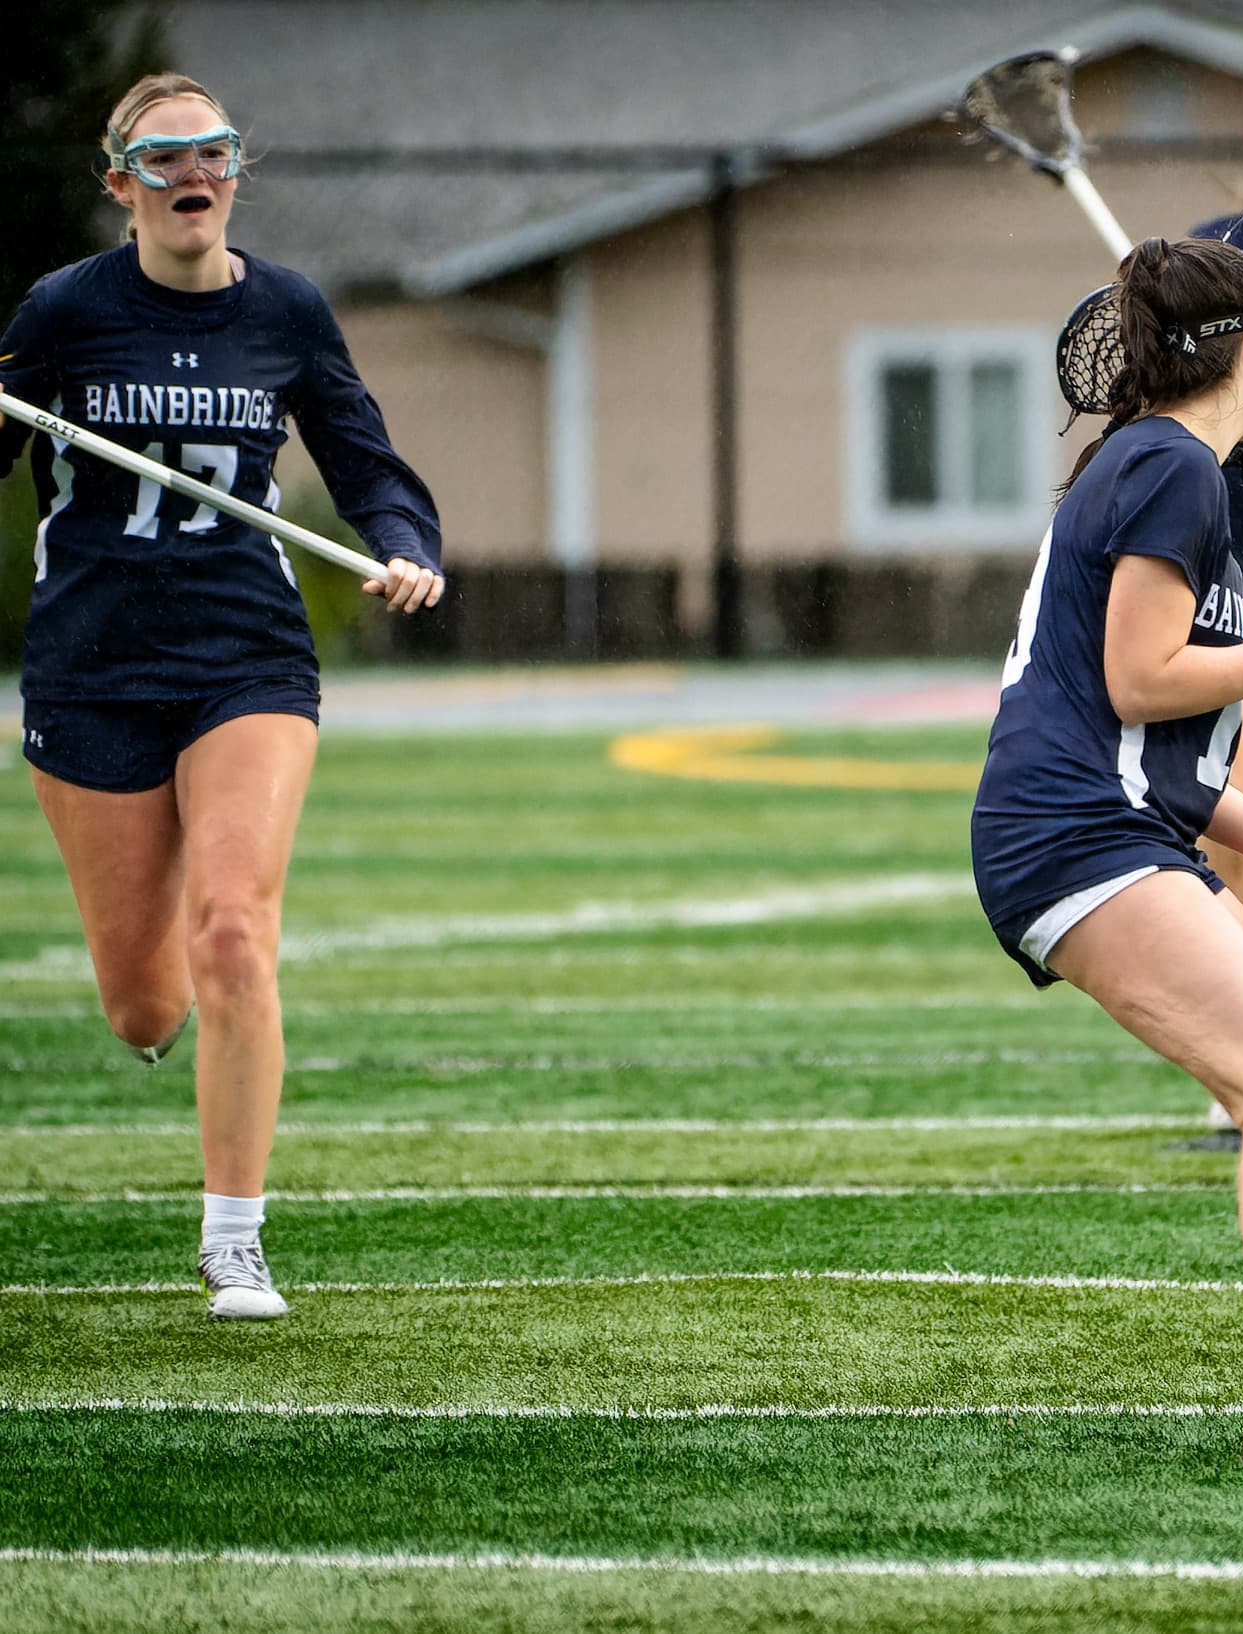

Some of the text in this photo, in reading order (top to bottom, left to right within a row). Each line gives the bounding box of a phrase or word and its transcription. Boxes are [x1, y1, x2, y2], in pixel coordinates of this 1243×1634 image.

[1199, 316, 1242, 338] STX
[85, 383, 276, 430] BAINBRIDGE
[35, 414, 80, 439] GAIT
[123, 441, 238, 540] 17
